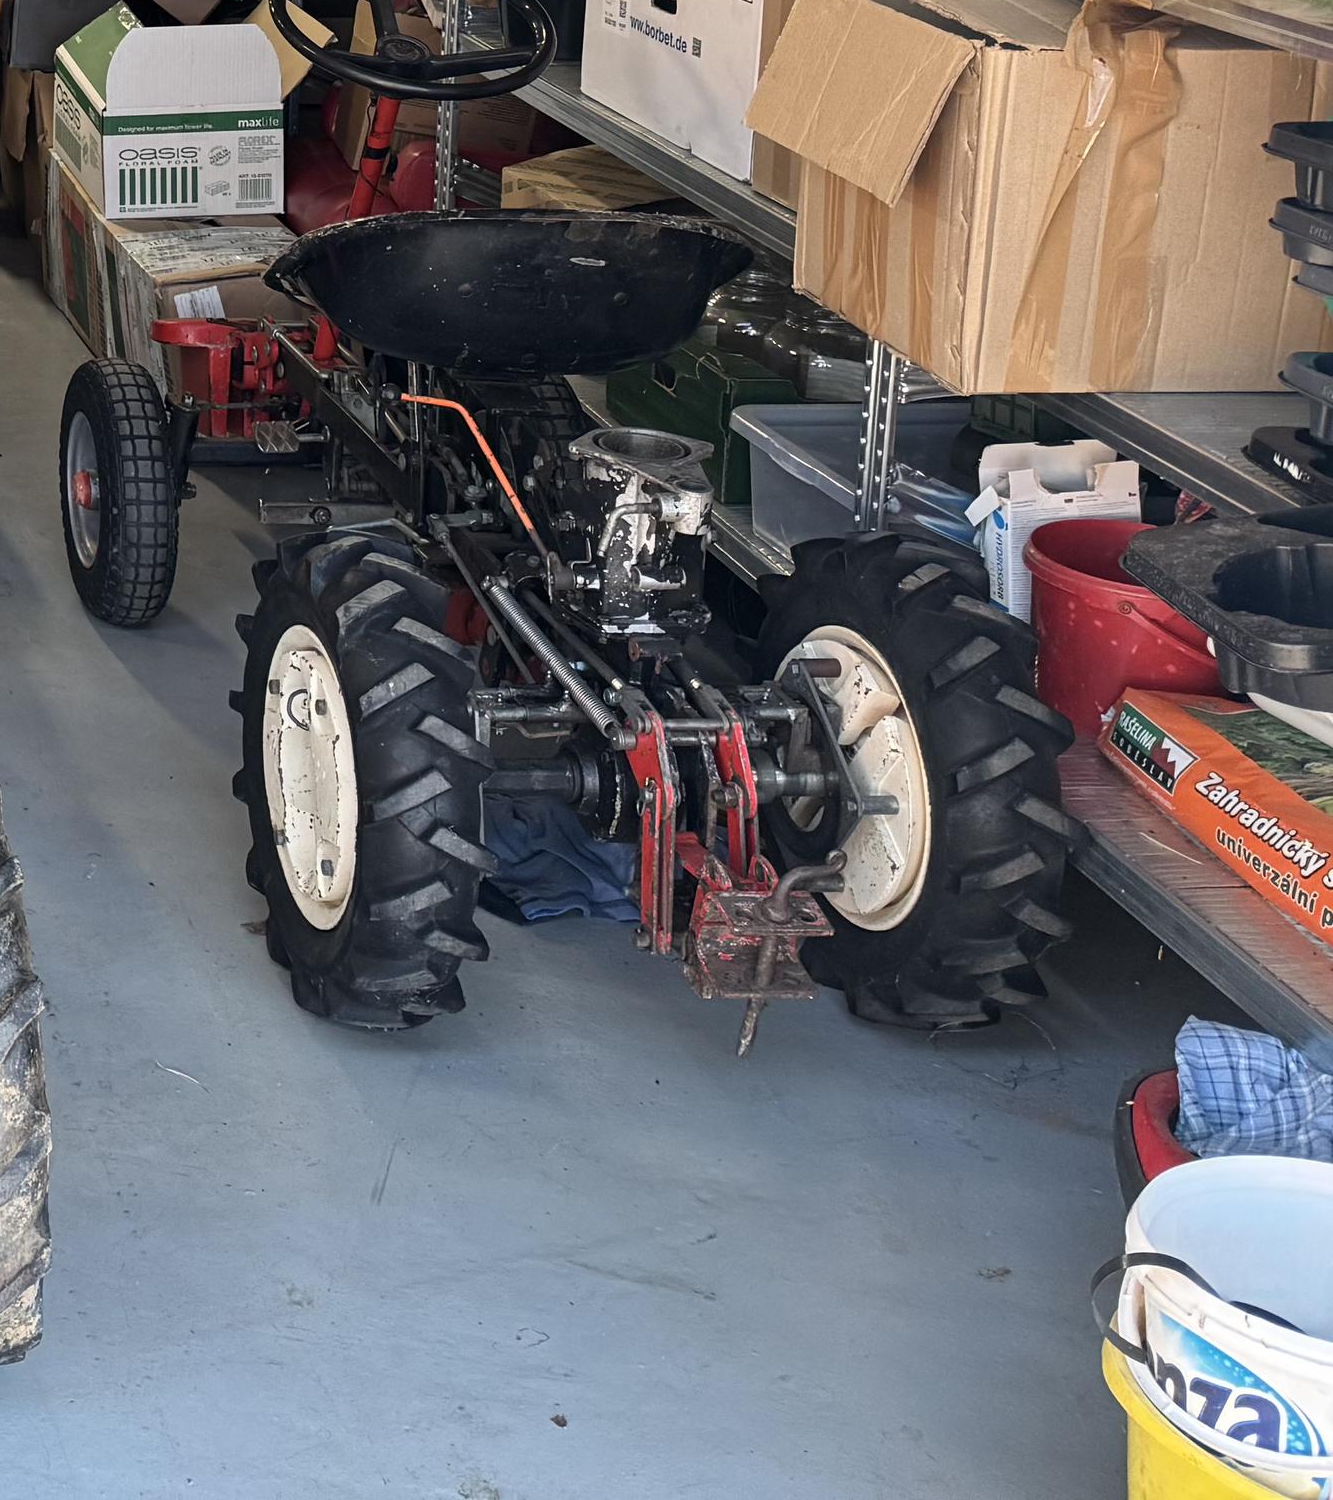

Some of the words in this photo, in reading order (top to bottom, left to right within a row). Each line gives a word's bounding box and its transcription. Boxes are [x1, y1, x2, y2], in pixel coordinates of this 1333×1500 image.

[629, 14, 688, 54] ww.borbet.de
[118, 125, 146, 134] Designed
[155, 124, 184, 132] maximum
[237, 117, 280, 129] maxlife
[995, 531, 1004, 600] HYDROSORB
[1118, 709, 1158, 751] RAŠELINA
[1194, 770, 1331, 879] Zahradnický
[1215, 826, 1319, 914] univerzální
